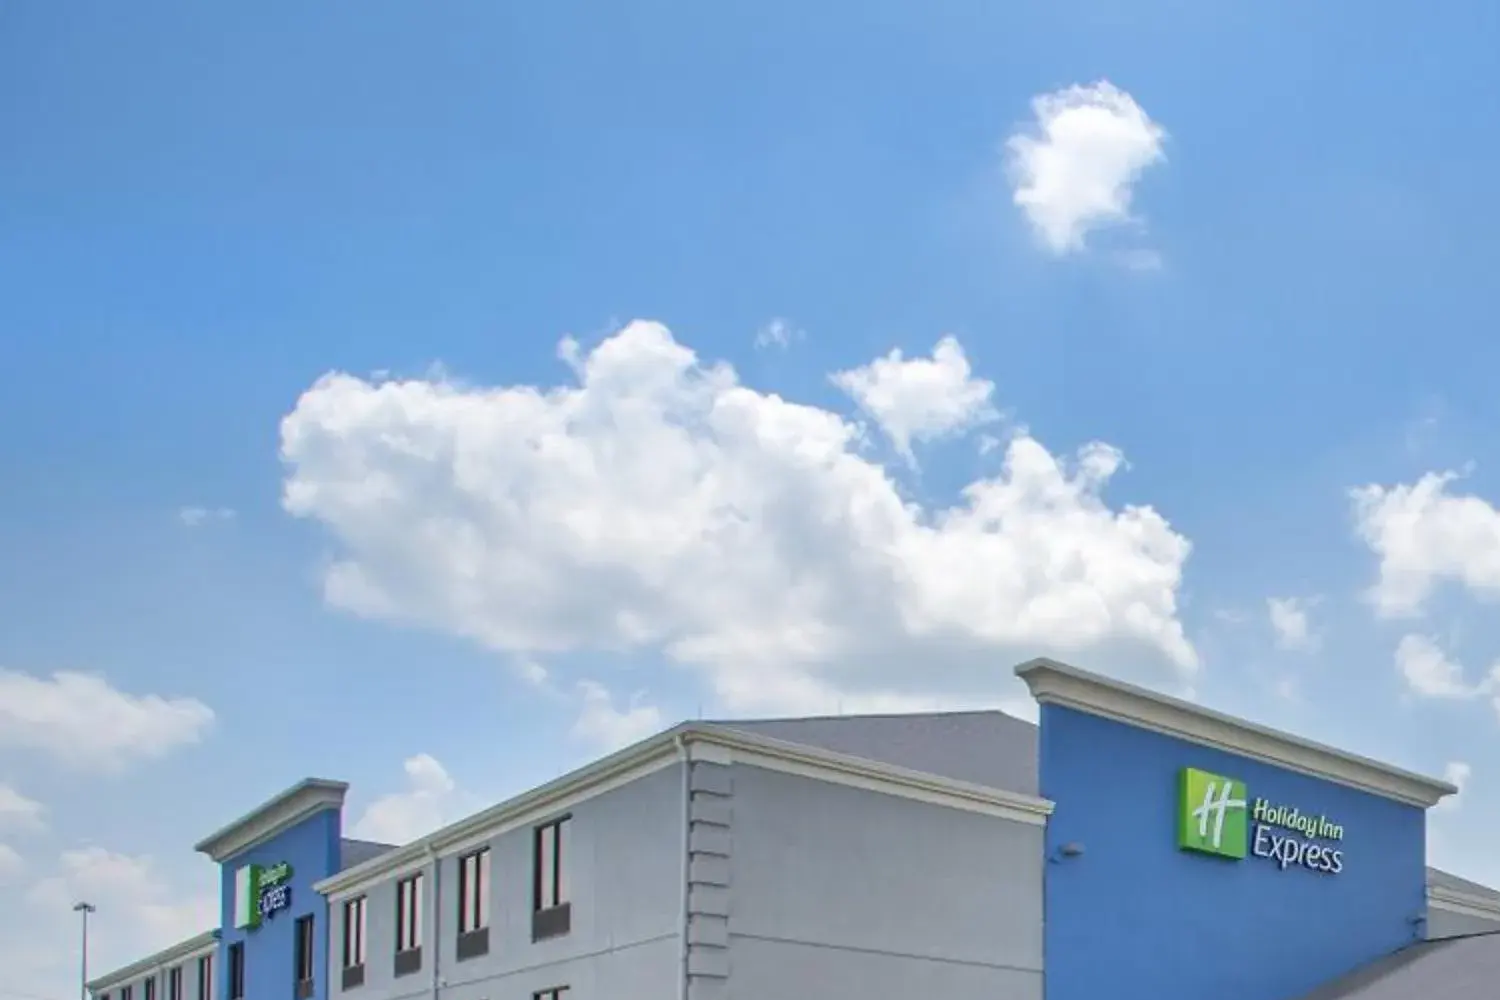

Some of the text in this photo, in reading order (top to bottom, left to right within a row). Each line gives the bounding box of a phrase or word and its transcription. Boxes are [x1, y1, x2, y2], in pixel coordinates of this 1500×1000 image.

[1253, 797, 1344, 841] Holiday Inn
[1253, 825, 1344, 874] Express
